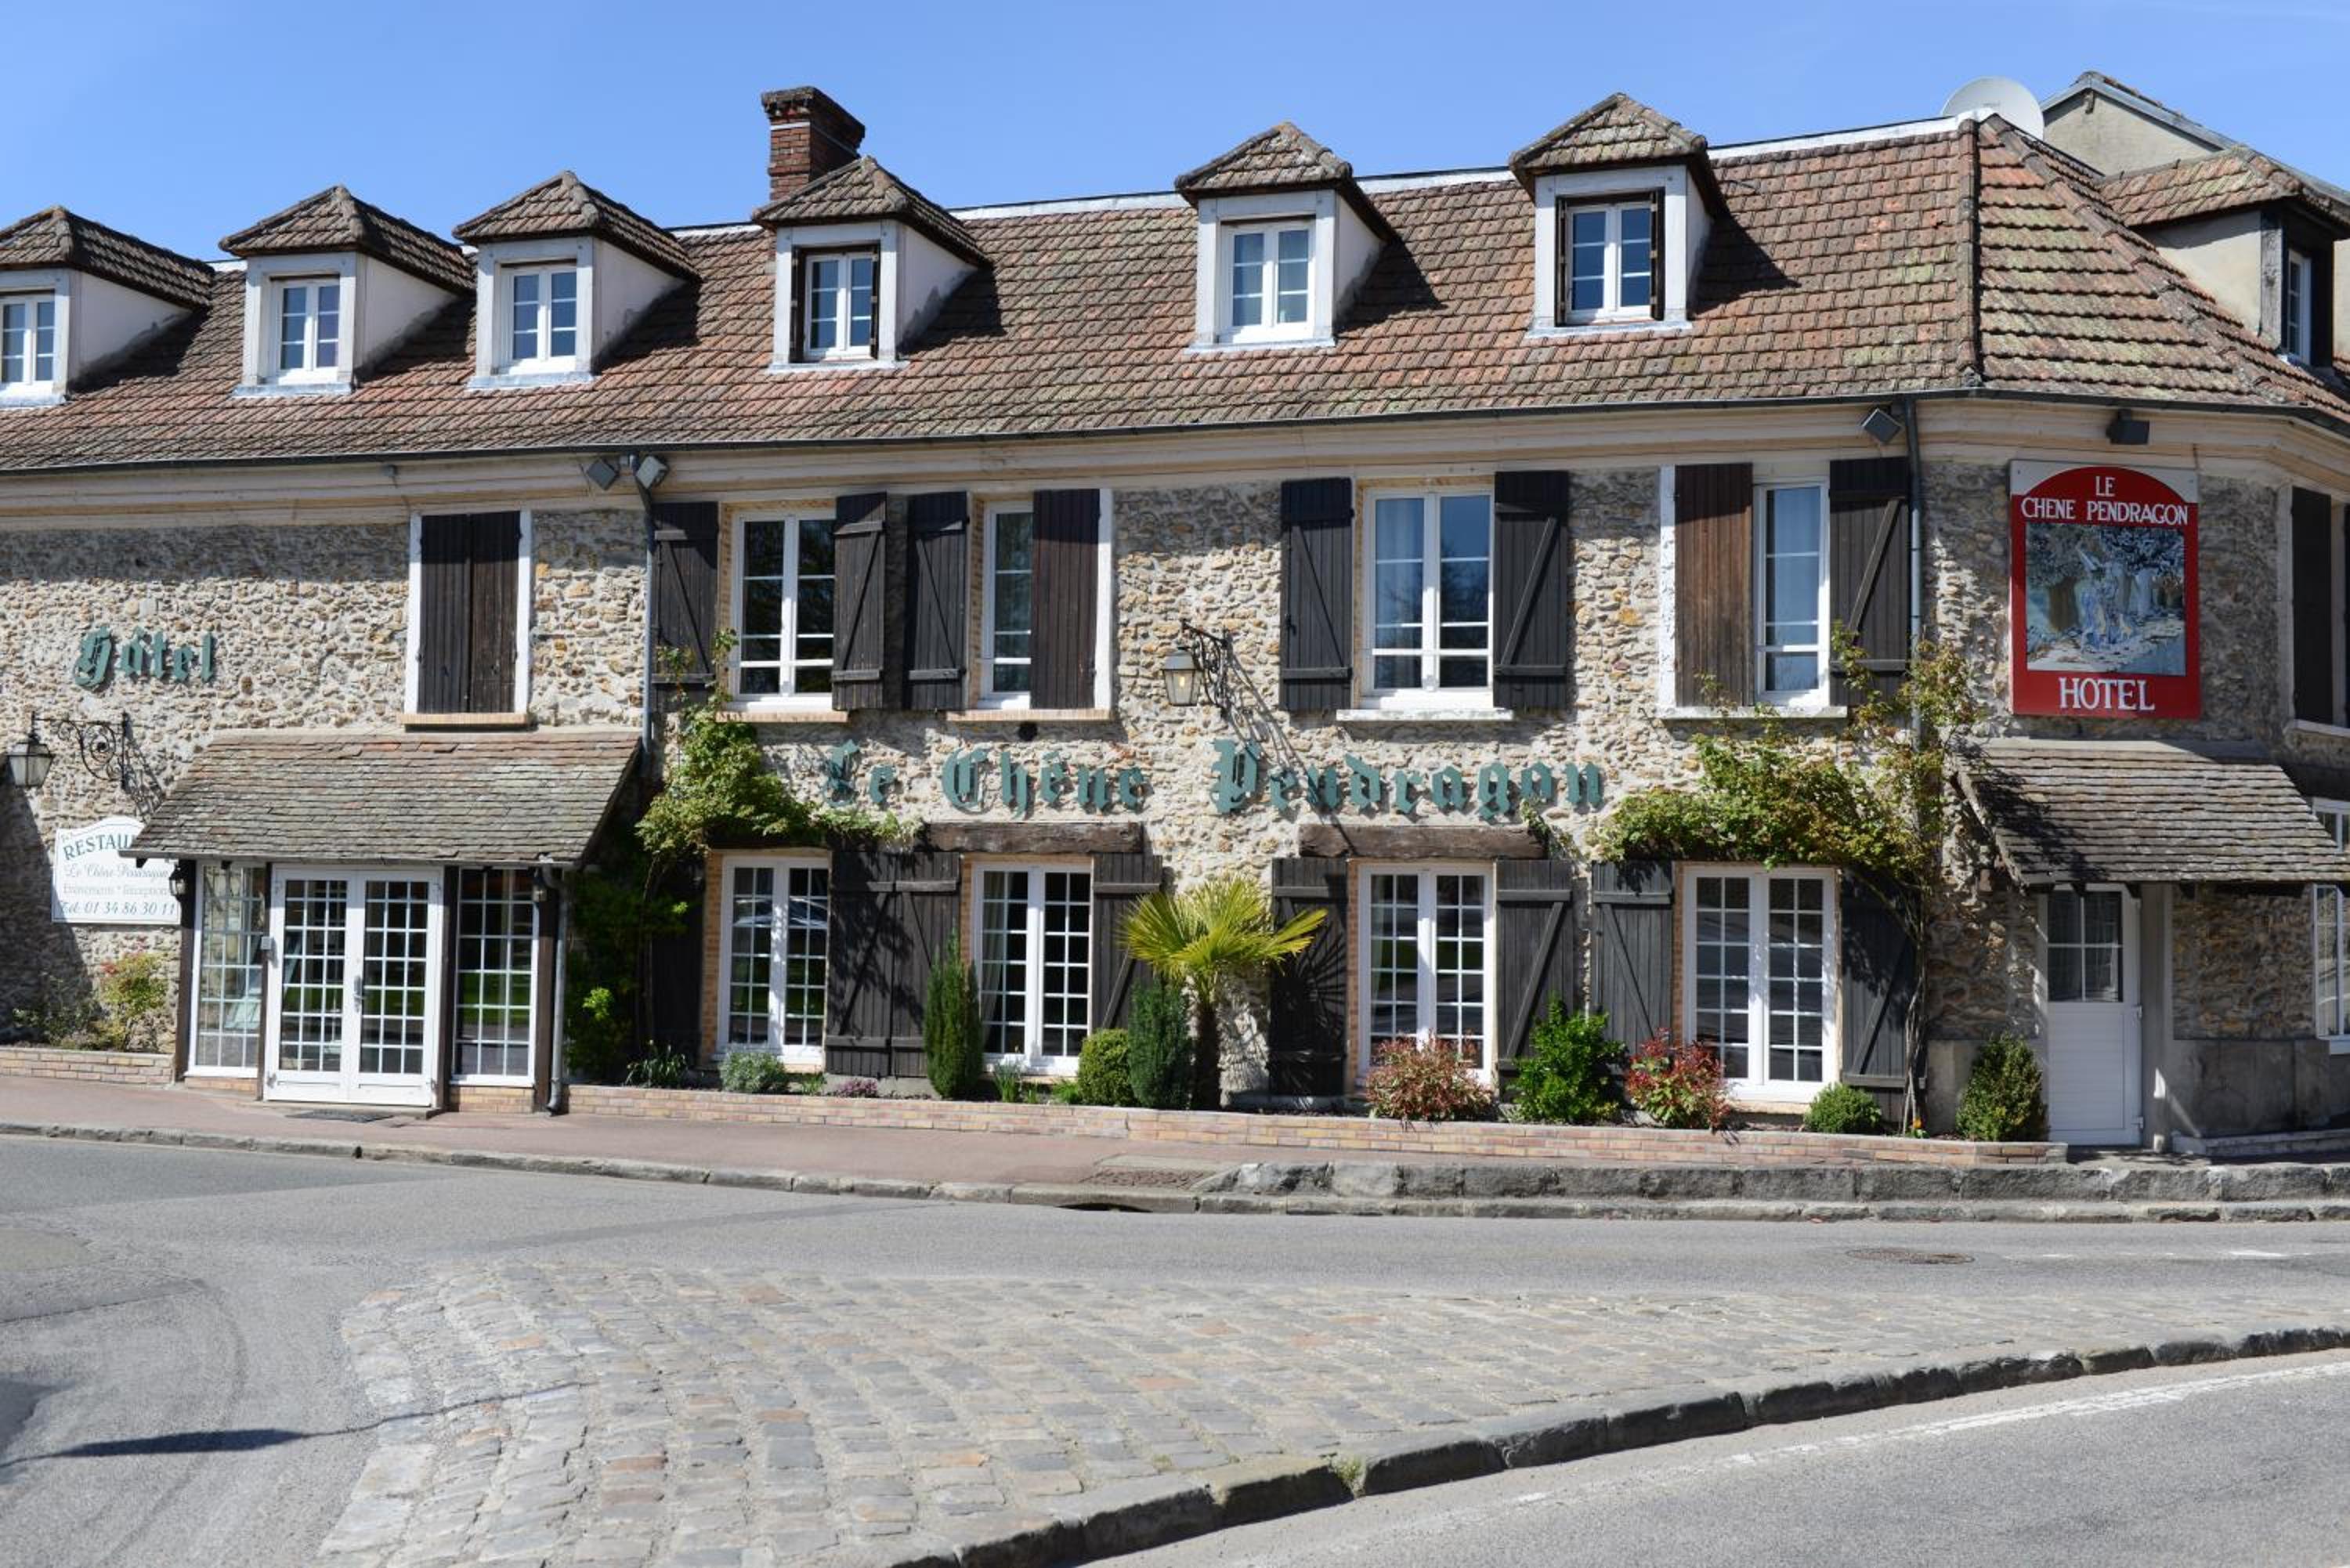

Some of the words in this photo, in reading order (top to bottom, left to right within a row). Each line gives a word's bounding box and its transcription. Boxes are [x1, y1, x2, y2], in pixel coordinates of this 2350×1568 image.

[2095, 476, 2116, 497] LE
[2020, 497, 2076, 519] CHENE
[2086, 501, 2189, 526] PENDRAGON
[74, 626, 215, 688] Hôtel
[2059, 677, 2156, 711] HOTEL
[942, 746, 1145, 820] Chêne
[1209, 739, 1602, 820] Pendragon
[63, 833, 136, 860] RESTAU
[84, 901, 99, 915] 01
[103, 901, 118, 915] 34
[142, 901, 157, 915] 30
[161, 901, 175, 915] 11
